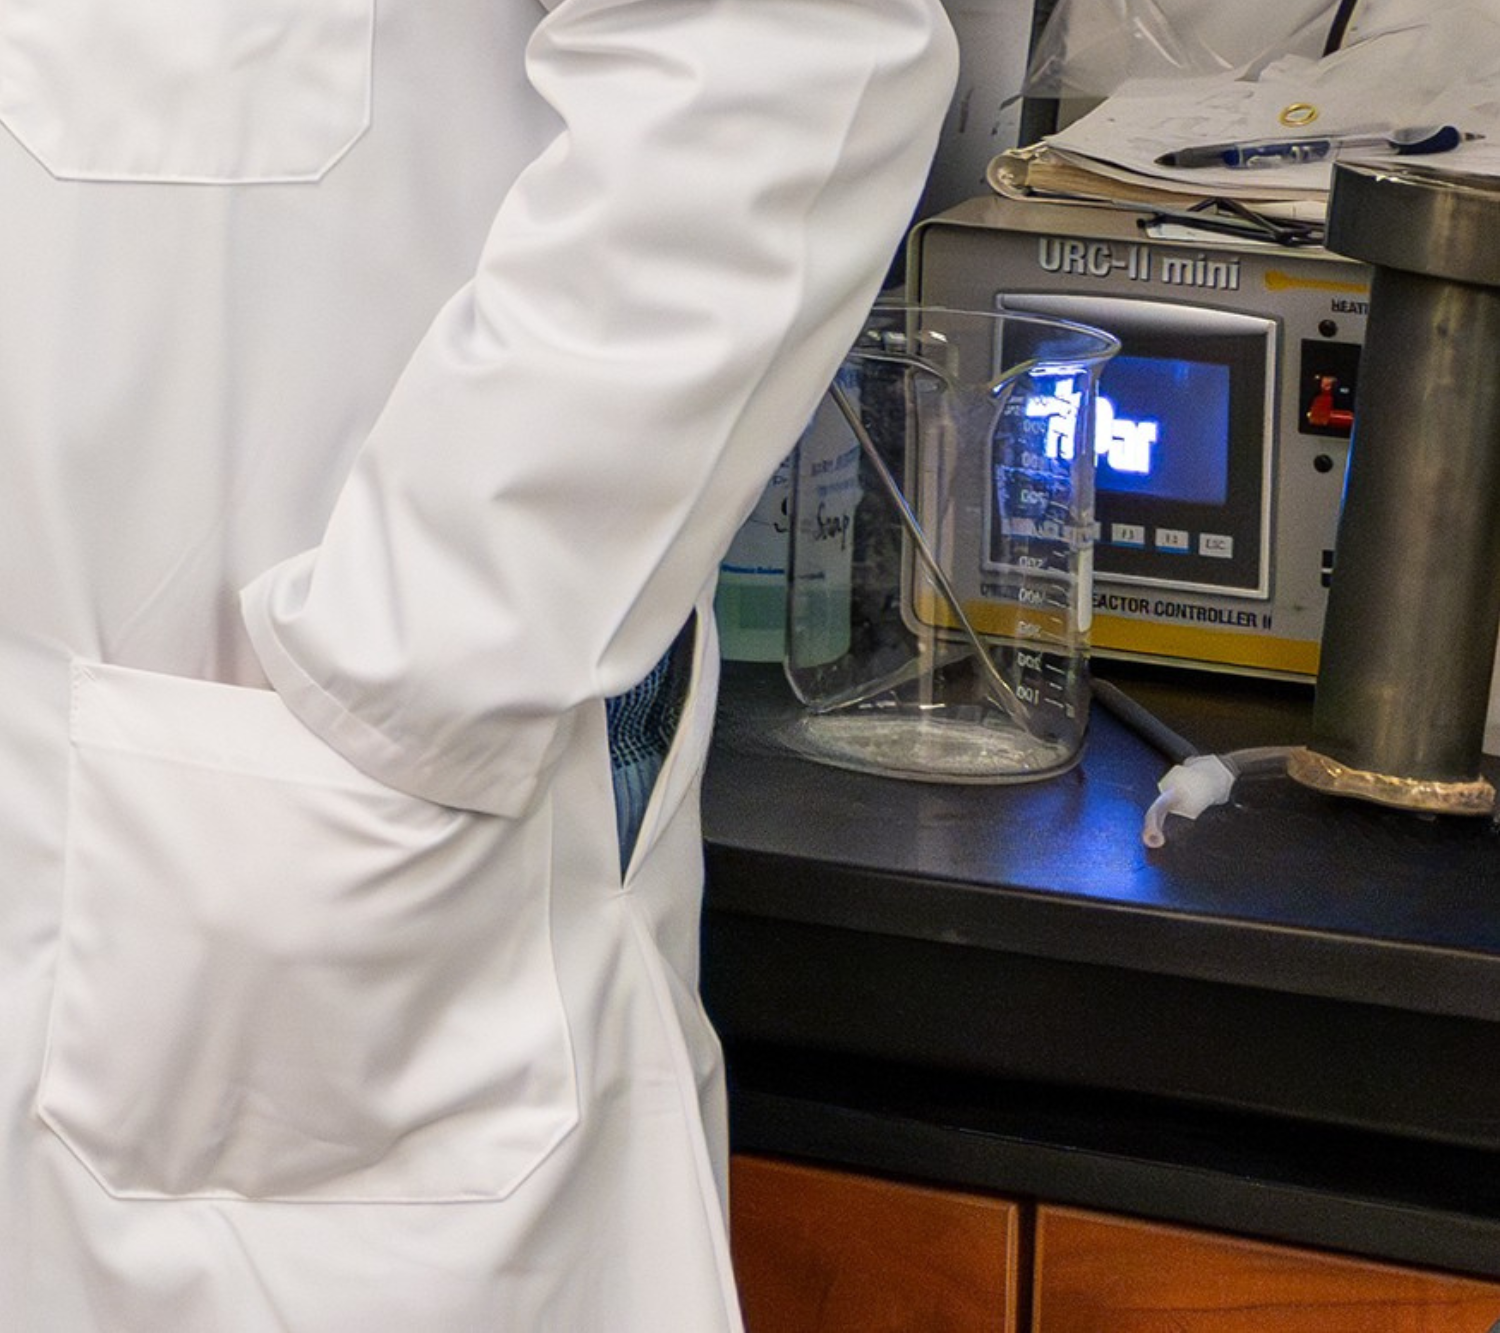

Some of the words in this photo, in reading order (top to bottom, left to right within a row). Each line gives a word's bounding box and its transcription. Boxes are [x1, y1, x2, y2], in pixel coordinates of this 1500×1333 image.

[1038, 238, 1151, 281] URC-II
[1161, 253, 1240, 291] mini
[1154, 599, 1257, 628] CONTROLLER
